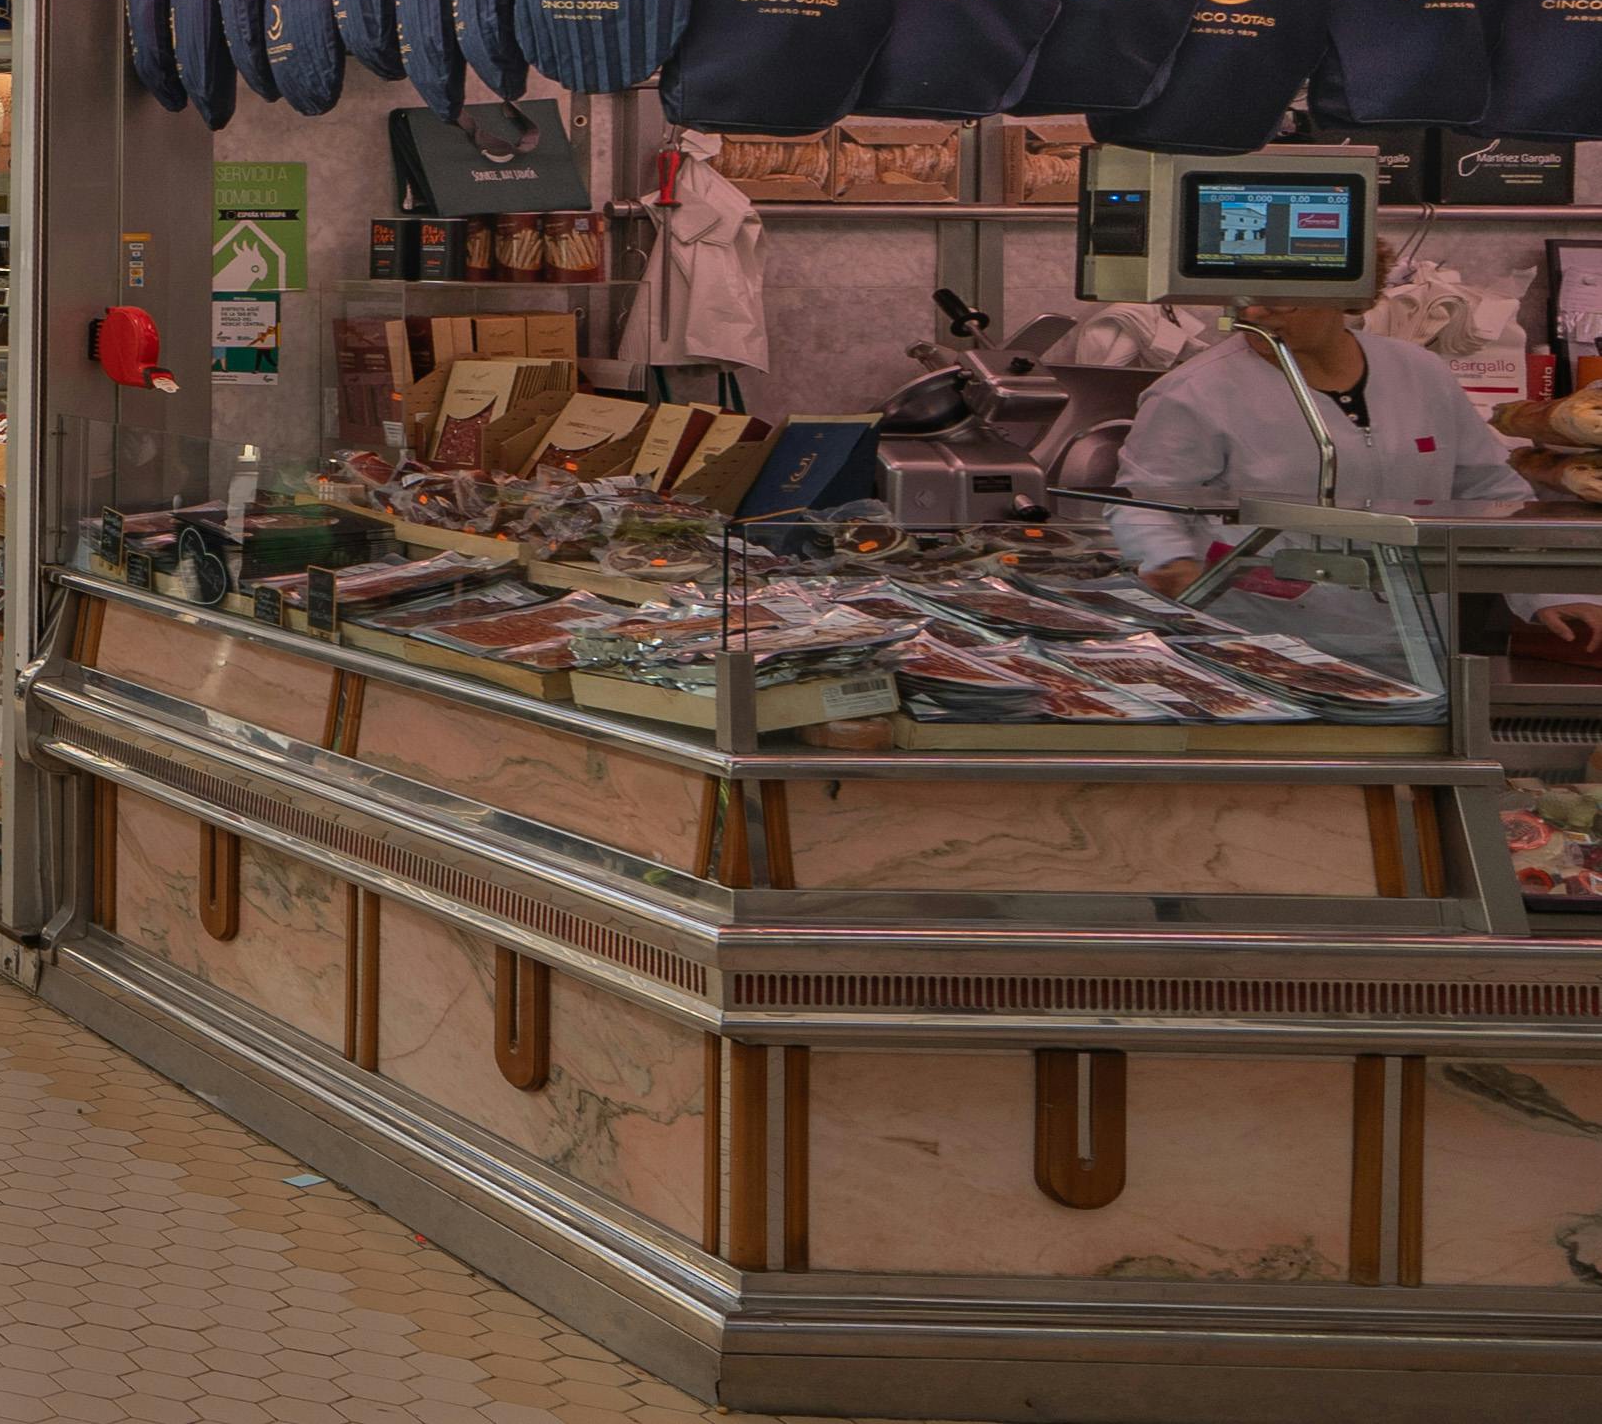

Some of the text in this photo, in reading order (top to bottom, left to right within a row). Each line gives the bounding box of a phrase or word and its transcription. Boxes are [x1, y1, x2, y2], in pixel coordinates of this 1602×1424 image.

[576, 0, 620, 12] JOTAS
[1230, 11, 1277, 28] JOTAS
[1378, 154, 1411, 166] argallo
[1520, 153, 1562, 167] Gargallo
[215, 166, 289, 183] SERVICIO A
[215, 187, 278, 206] DOMICILIO
[1449, 358, 1517, 375] Gargallo
